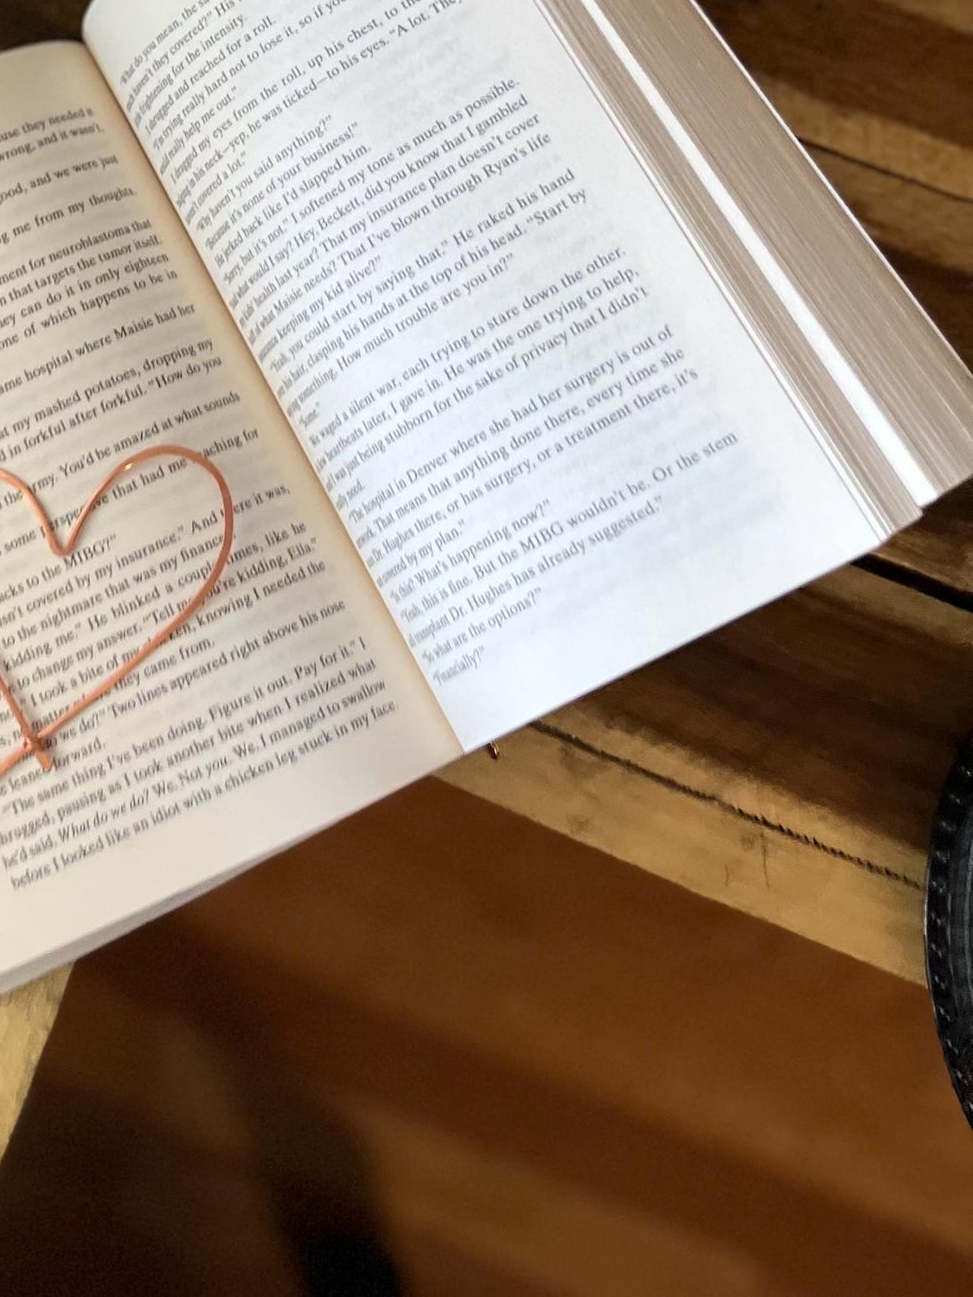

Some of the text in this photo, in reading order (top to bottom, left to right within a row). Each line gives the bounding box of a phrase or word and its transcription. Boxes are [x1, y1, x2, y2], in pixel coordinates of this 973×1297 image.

[180, 3, 198, 21] the
[181, 90, 206, 119] really
[203, 69, 229, 97] hard
[228, 58, 248, 78] not
[246, 49, 260, 63] to
[258, 33, 284, 55] lose
[282, 25, 299, 38] it,
[298, 14, 313, 29] so
[312, 3, 325, 19] if
[212, 117, 234, 139] eyes
[232, 97, 260, 122] from
[259, 83, 279, 101] the
[280, 64, 307, 87] roll,
[306, 53, 324, 69] up
[323, 40, 346, 58] his
[346, 18, 384, 44] chest,
[383, 6, 399, 21] to
[21, 119, 47, 135] they
[267, 78, 521, 244] not." I softened my tone as much as possible.
[293, 93, 529, 249] Hey, Beckett, did you know that I gambled
[12, 222, 32, 238] me
[34, 208, 65, 228] from
[67, 201, 85, 215] my
[303, 133, 552, 293] needs? That I've blown through Ryan's life
[330, 167, 576, 324] start by saying that." He raked his hand
[20, 300, 43, 319] can
[45, 291, 63, 307] do
[64, 285, 76, 298] it
[77, 279, 92, 293] in
[94, 267, 121, 286] only
[123, 253, 170, 274] eighteen
[23, 348, 74, 383] hospital
[74, 334, 113, 357] where
[112, 317, 155, 341] Maisie
[154, 306, 178, 325] had
[176, 303, 196, 317] her
[348, 246, 626, 417] silent war, each trying to stare down the other.
[356, 285, 649, 463] being stubborn for the sake of privacy that I didn't
[25, 578, 75, 614] covered
[74, 572, 92, 589] by
[94, 562, 113, 581] my
[191, 509, 219, 535] And
[471, 432, 739, 581] But the MIBG wouldn't be. Or the stem
[123, 657, 377, 788] I took another bite when I realized what
